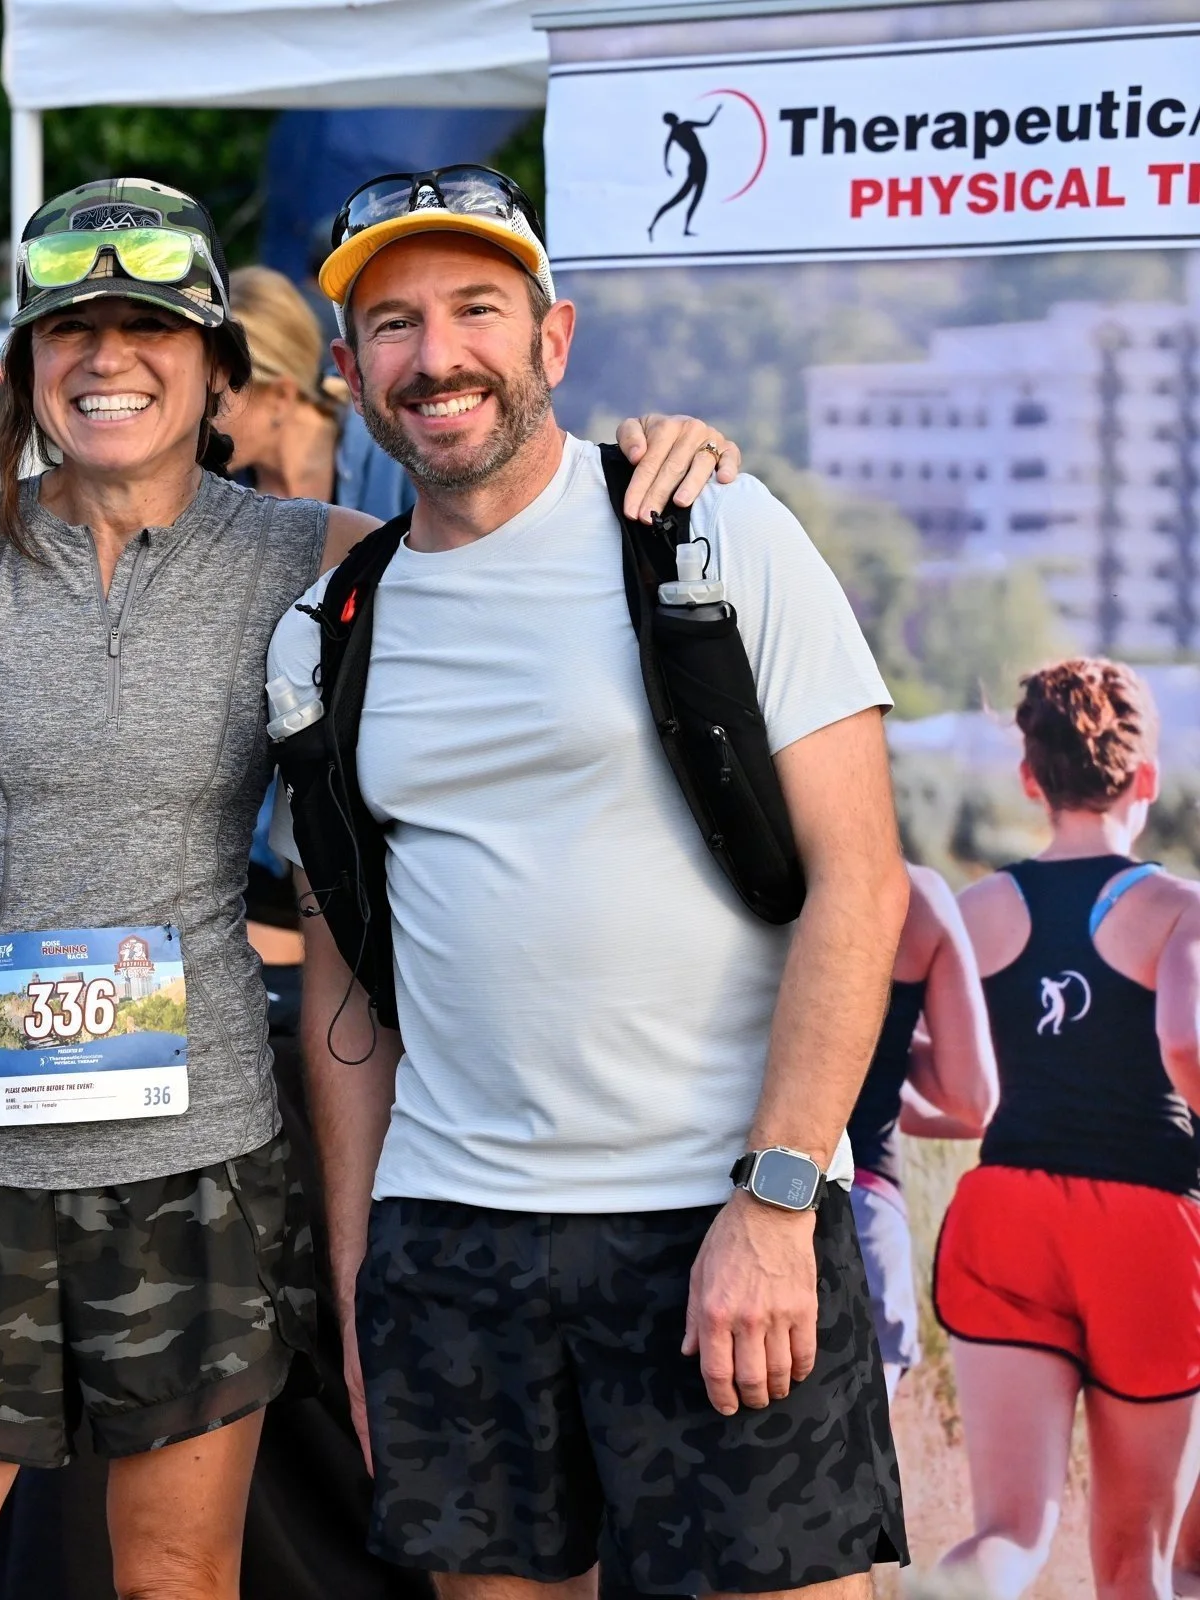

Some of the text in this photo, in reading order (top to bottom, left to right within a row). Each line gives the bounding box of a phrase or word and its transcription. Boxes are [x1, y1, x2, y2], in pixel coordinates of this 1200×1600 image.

[849, 165, 1126, 219] PHYSICAL
[42, 944, 88, 956] RUNNING
[23, 978, 116, 1040] 336
[21, 1085, 45, 1093] COMPLETE
[46, 1084, 65, 1092] BEFORE
[143, 1085, 171, 1106] 336
[787, 1178, 803, 1201] 07:25
